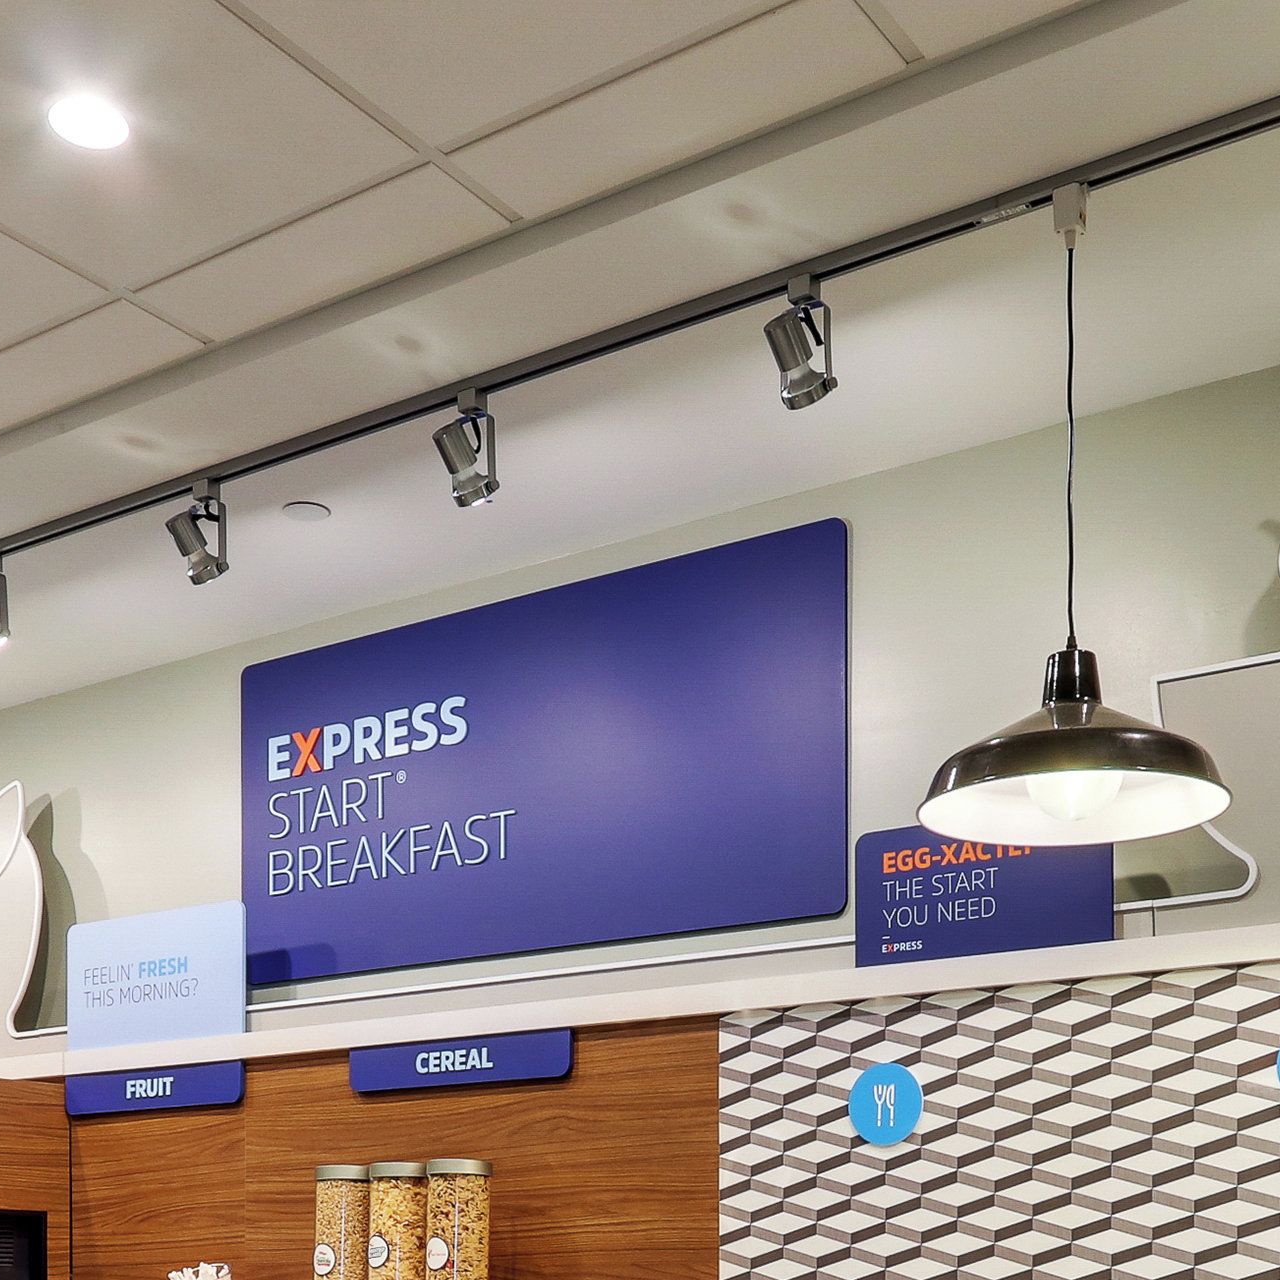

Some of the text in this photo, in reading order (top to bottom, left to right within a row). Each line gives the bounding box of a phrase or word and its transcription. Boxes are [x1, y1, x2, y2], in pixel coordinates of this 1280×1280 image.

[267, 695, 468, 782] EXPRESS
[269, 809, 516, 896] BREAKFAST
[882, 867, 999, 901] THE START
[882, 896, 997, 929] YOU NEED
[881, 940, 923, 954] EXPRESS
[84, 956, 188, 986] FEELIN' FRESH
[84, 978, 199, 1009] THIS MORNING?
[415, 1047, 494, 1074] CEREAL
[125, 1076, 175, 1099] FRUIT
